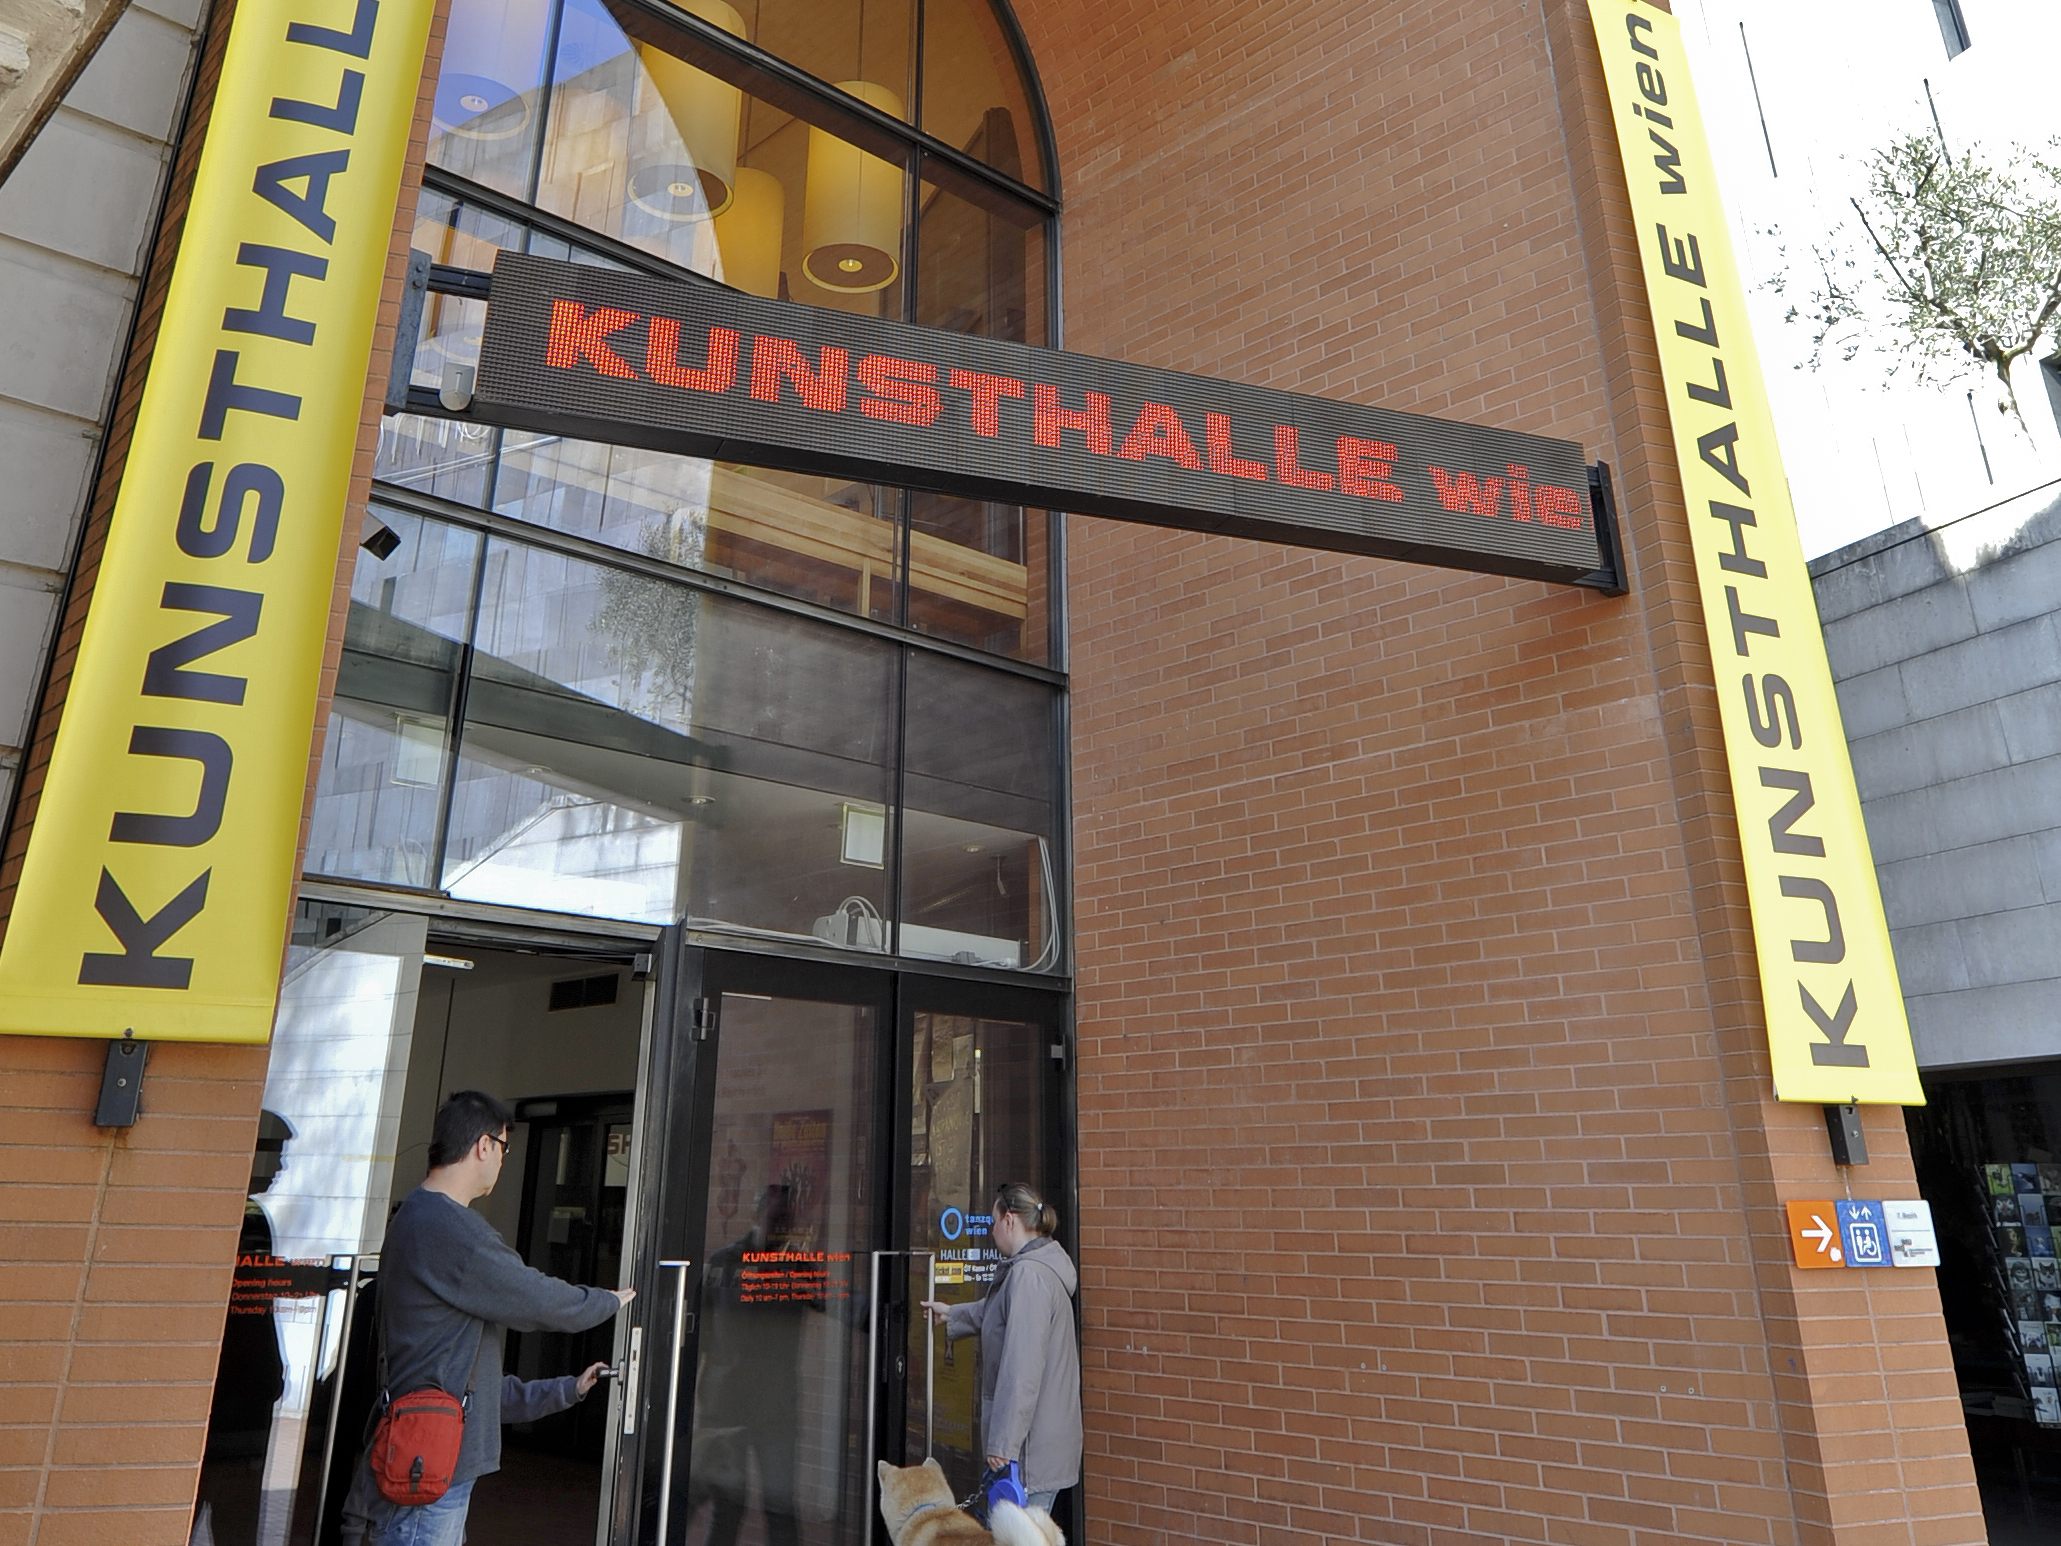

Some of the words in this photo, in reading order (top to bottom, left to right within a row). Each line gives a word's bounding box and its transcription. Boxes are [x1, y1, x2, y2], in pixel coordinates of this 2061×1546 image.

[1626, 13, 1687, 194] wien
[77, 0, 379, 989] KUNSTHALL
[546, 300, 1403, 500] KUNSTHALLE
[1427, 464, 1594, 530] wie
[1656, 222, 1870, 1070] KUNSTHALLE
[742, 1251, 825, 1262] KUNSTHALLE
